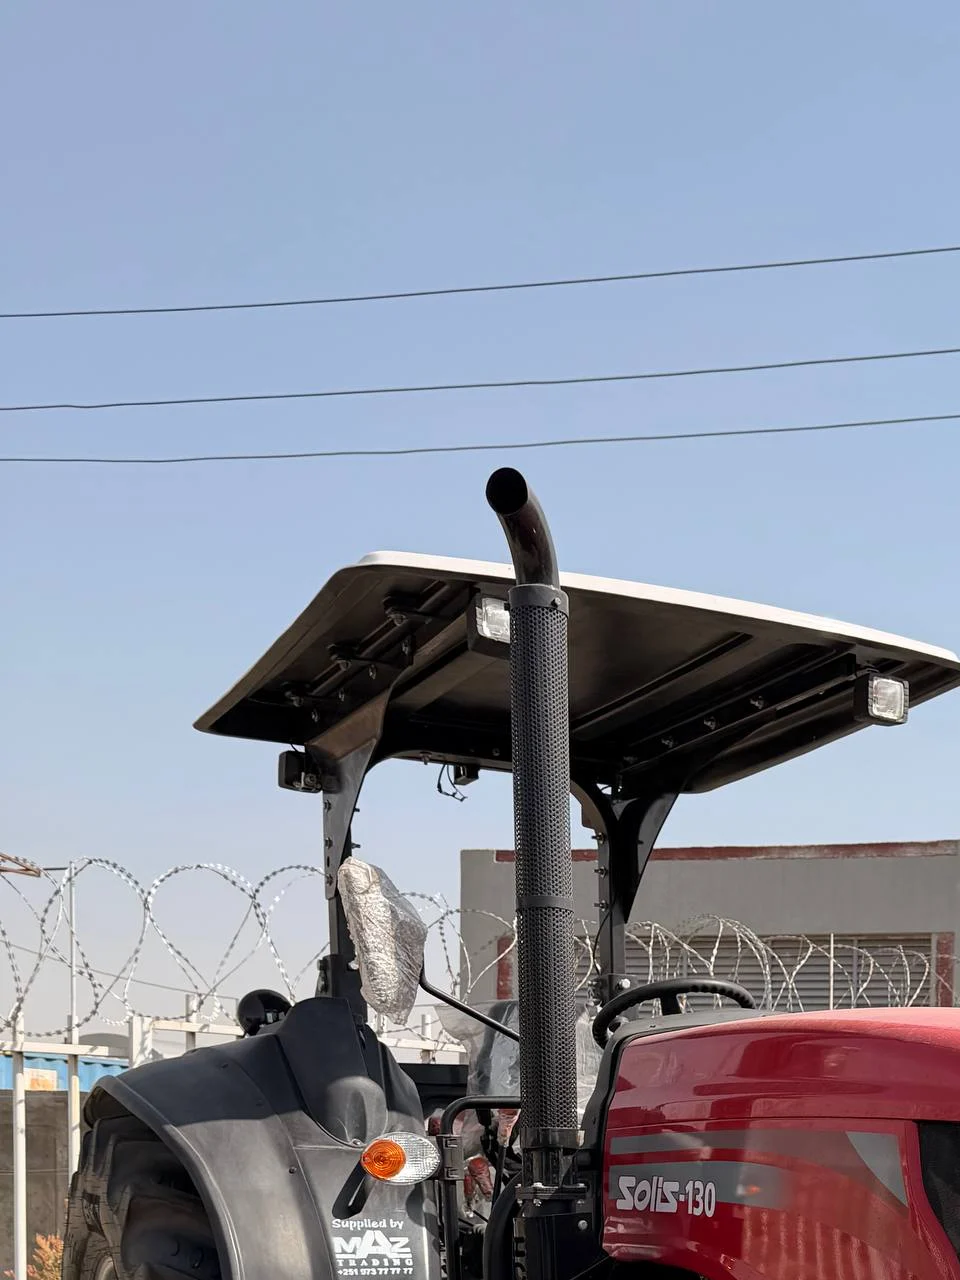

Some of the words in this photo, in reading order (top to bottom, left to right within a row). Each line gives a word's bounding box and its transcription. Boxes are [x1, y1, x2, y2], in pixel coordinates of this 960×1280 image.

[331, 1218, 387, 1230] Supplied
[389, 1219, 404, 1230] by
[332, 1230, 413, 1259] MAZ
[336, 1258, 414, 1267] TRADING
[337, 1268, 359, 1276] +251
